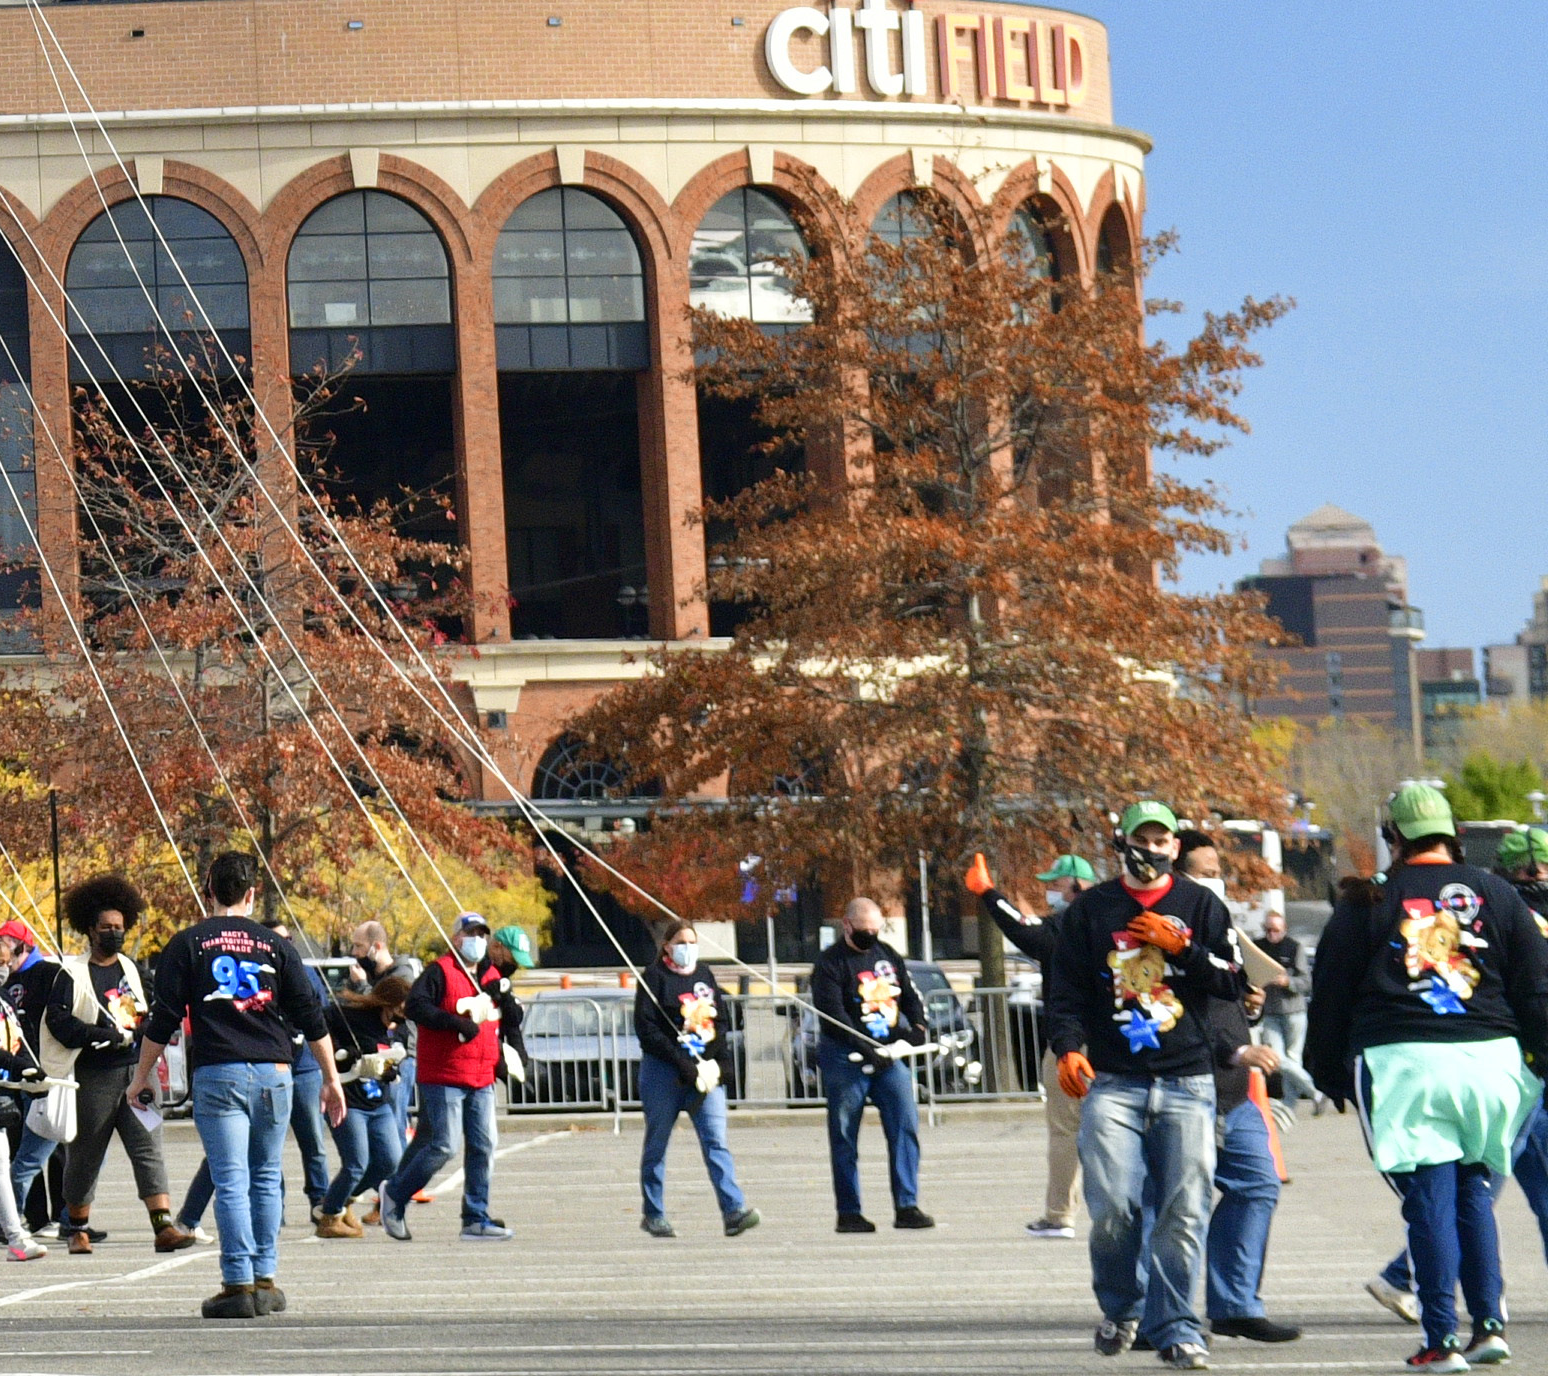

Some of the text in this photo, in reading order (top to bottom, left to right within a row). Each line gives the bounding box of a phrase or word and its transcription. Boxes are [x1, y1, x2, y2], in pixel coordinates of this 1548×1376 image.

[937, 13, 1087, 108] FIELD
[221, 930, 249, 938] MACY'S
[221, 944, 252, 953] PARADE
[256, 941, 272, 952] DAY
[211, 955, 260, 999] 95
